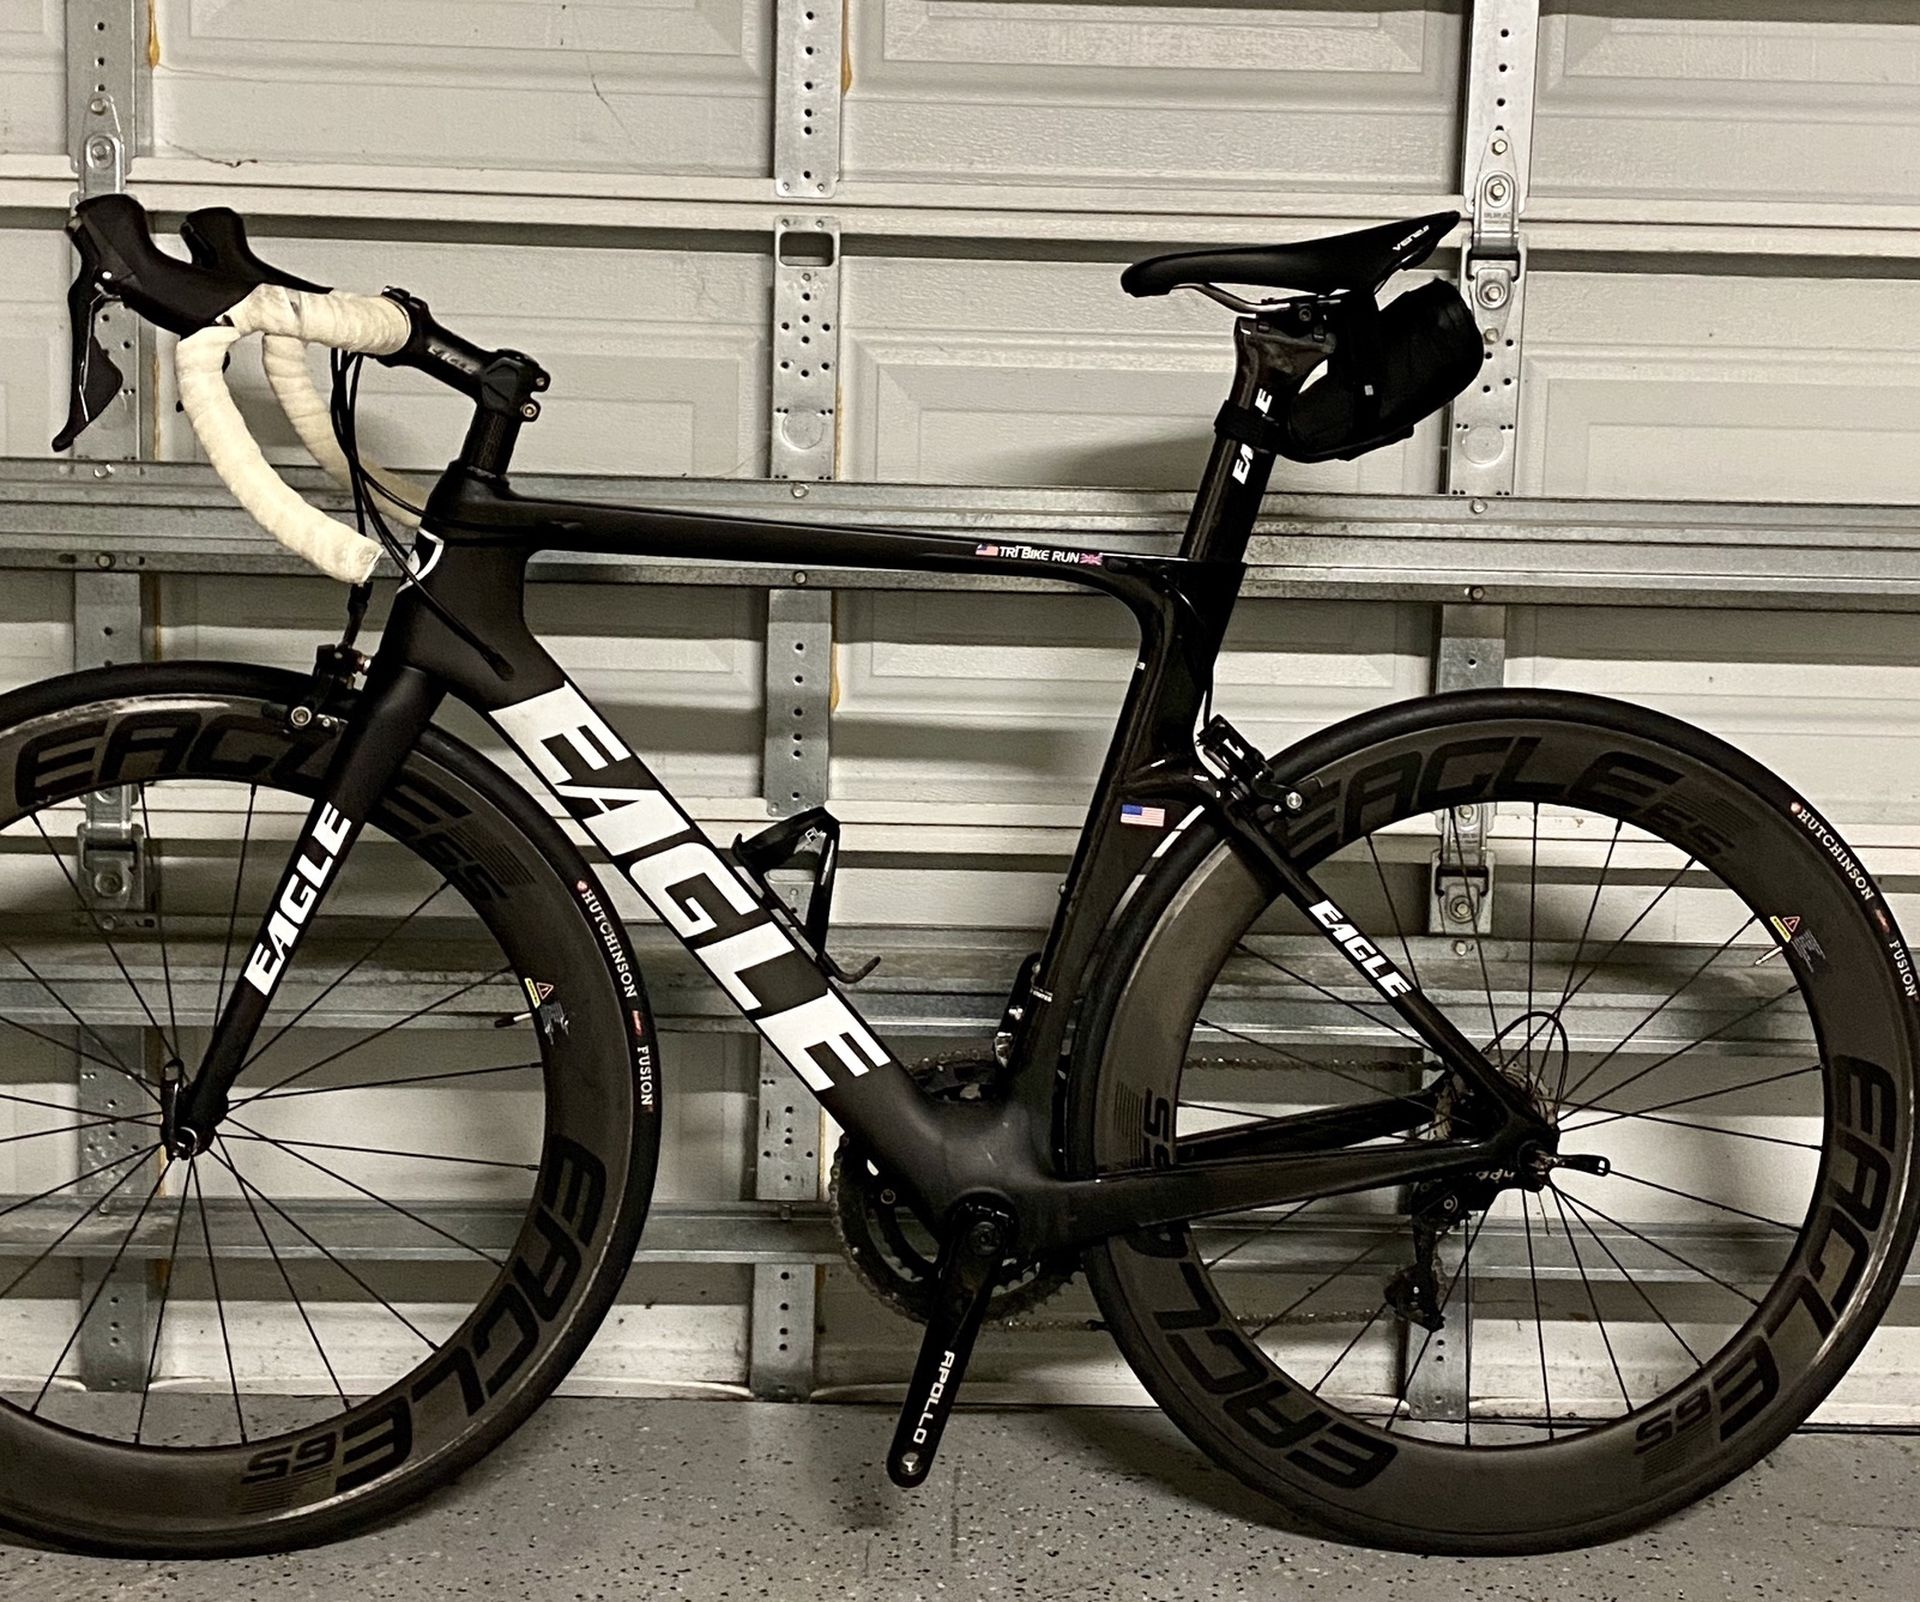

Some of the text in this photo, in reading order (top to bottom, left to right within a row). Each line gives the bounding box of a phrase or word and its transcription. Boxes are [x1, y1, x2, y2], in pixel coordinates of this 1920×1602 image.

[1052, 551, 1079, 563] RUN
[243, 801, 352, 996] EAGLE
[489, 682, 891, 1091] EAGLE
[1309, 900, 1413, 998] EAGLE
[1797, 808, 1875, 900] HUTCHINSON
[1889, 939, 1918, 997] FUSION
[581, 888, 653, 1106] HUTCHINSON FUSION
[240, 1137, 607, 1492] EAGLE 65
[1715, 1056, 1896, 1442] EAGLE
[914, 1350, 956, 1444] APOLLO
